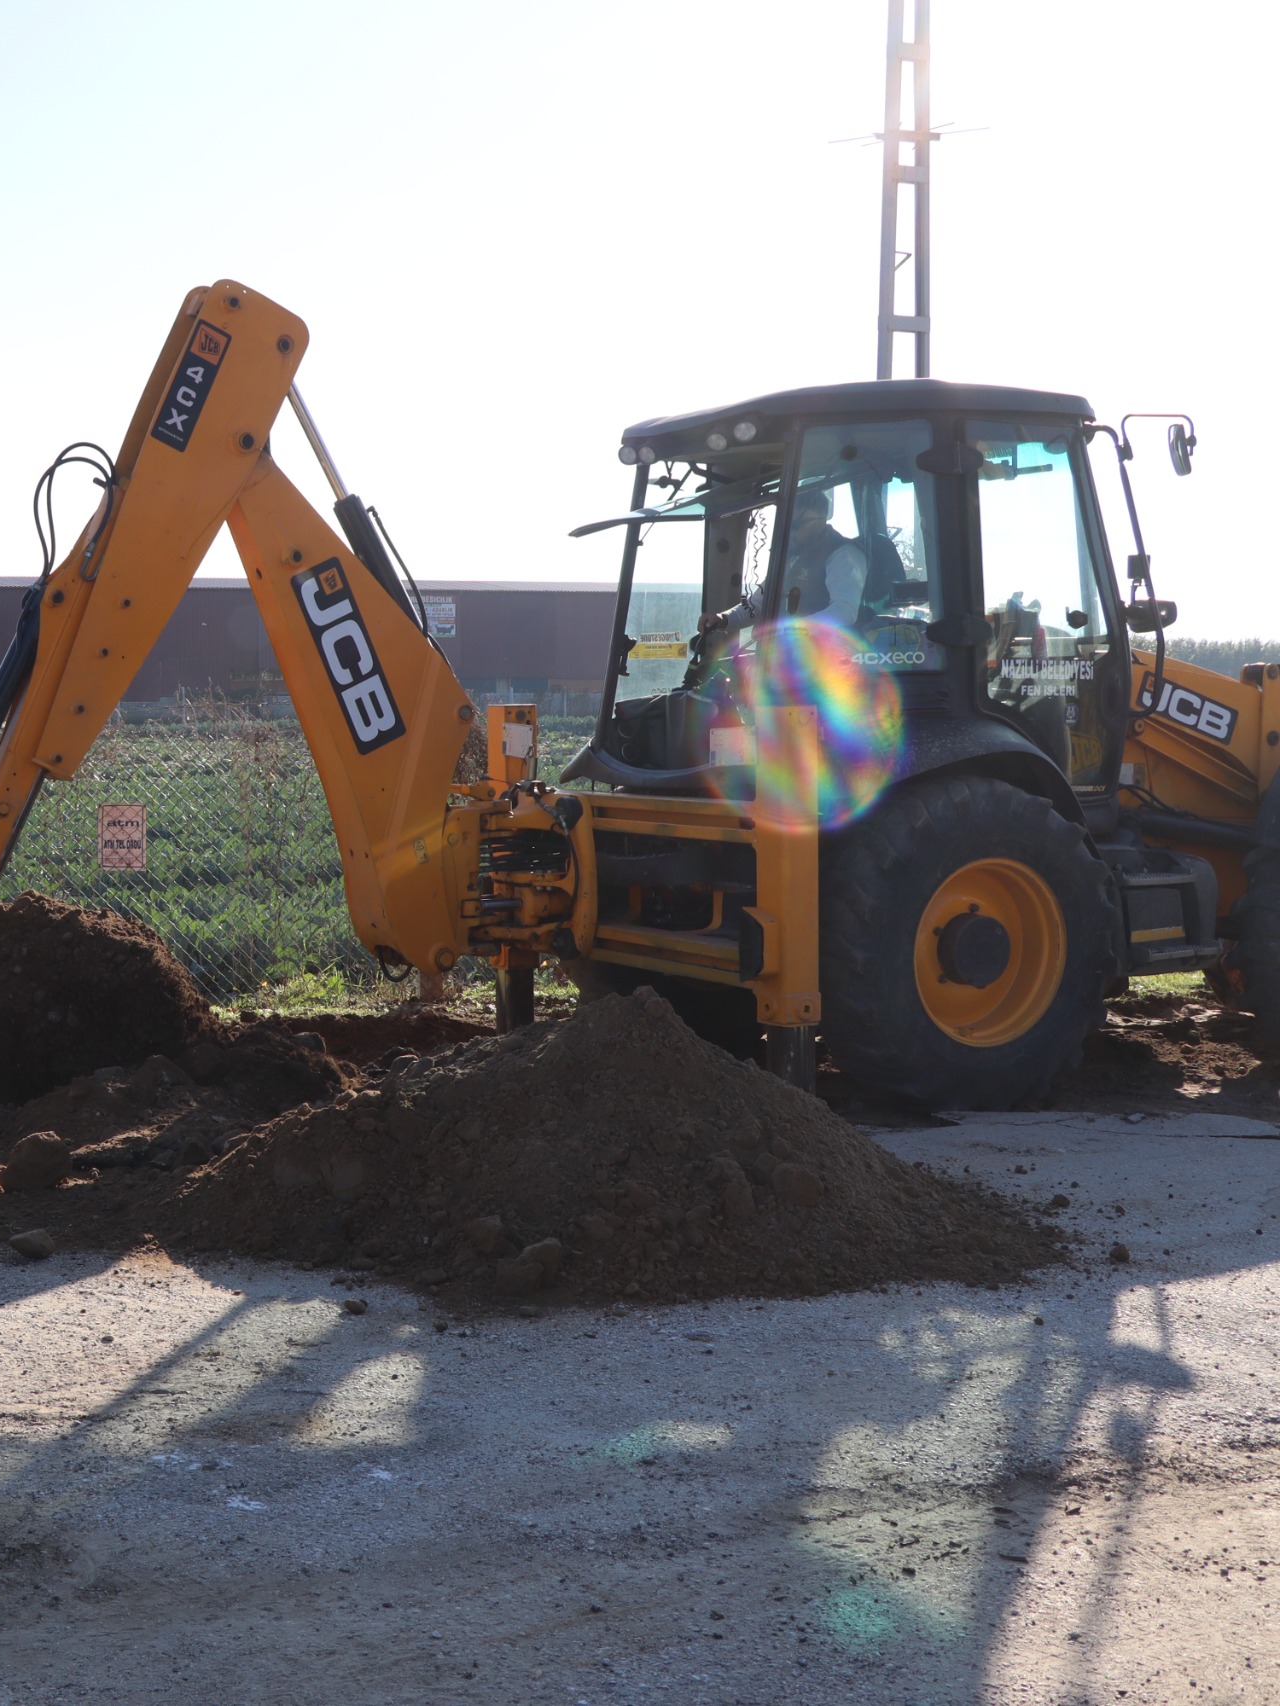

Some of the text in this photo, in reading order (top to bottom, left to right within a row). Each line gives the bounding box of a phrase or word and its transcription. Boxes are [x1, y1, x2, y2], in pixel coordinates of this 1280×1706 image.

[200, 332, 220, 354] JCB
[165, 366, 205, 433] 4CX
[300, 576, 396, 743] JCB
[851, 651, 926, 665] 4CXeco
[1021, 685, 1040, 696] FEN
[1142, 682, 1232, 739] JCB
